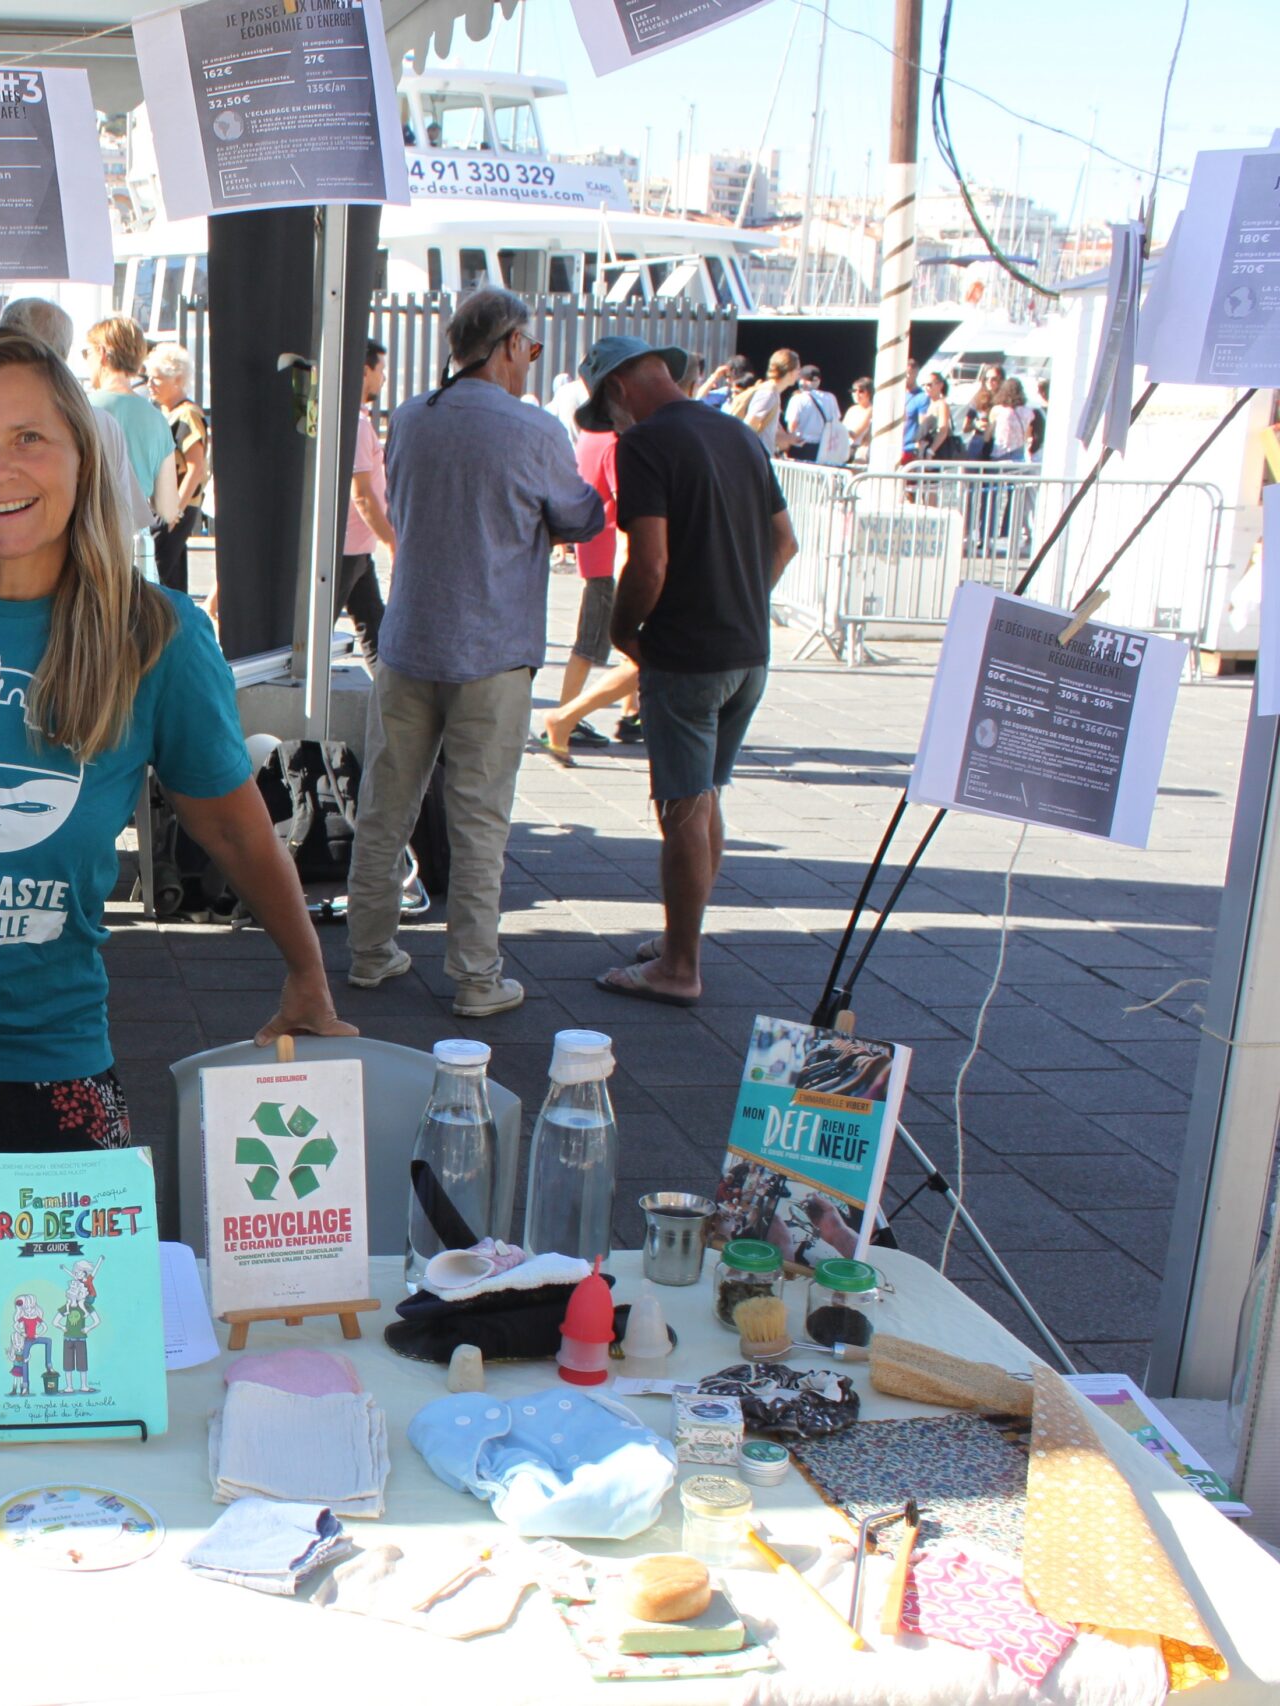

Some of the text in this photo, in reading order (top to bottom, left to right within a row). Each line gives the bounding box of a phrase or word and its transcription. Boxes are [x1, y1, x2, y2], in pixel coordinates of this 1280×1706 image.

[226, 7, 278, 28] JE PASSE
[304, 54, 325, 64] 27€
[203, 66, 233, 79] 162€
[307, 83, 346, 93] 135€/an
[208, 94, 251, 110] 32,50€
[410, 160, 556, 186] 4 91 330 329
[410, 181, 584, 202] e-des-calanques.com
[1239, 233, 1271, 244] 180€
[1232, 265, 1265, 274] 270€
[994, 618, 1054, 646] JE DÉGIVRE LE
[1091, 630, 1144, 667] #15
[988, 670, 1006, 682] 60€
[982, 696, 1035, 718] -30% -50%
[1057, 690, 1113, 710] -30% à -50%
[1053, 715, 1118, 739] 18€ +36€/an
[257, 1075, 274, 1084] FLORE
[846, 1101, 869, 1110] VIBERT
[742, 1100, 861, 1152] MON DÉFI RIEN DE
[818, 1133, 869, 1163] NEUF
[19, 1187, 91, 1209] Famille
[43, 1206, 142, 1241] DECHET
[223, 1208, 352, 1242] RECYCLAGE
[33, 1243, 70, 1252] ZE GUIDE
[224, 1233, 352, 1252] LE GRAND ENFUMAGE
[234, 1252, 266, 1260] COMMENT
[306, 1246, 343, 1255] CIRCULAIRE
[251, 1257, 281, 1265] DEVENUE
